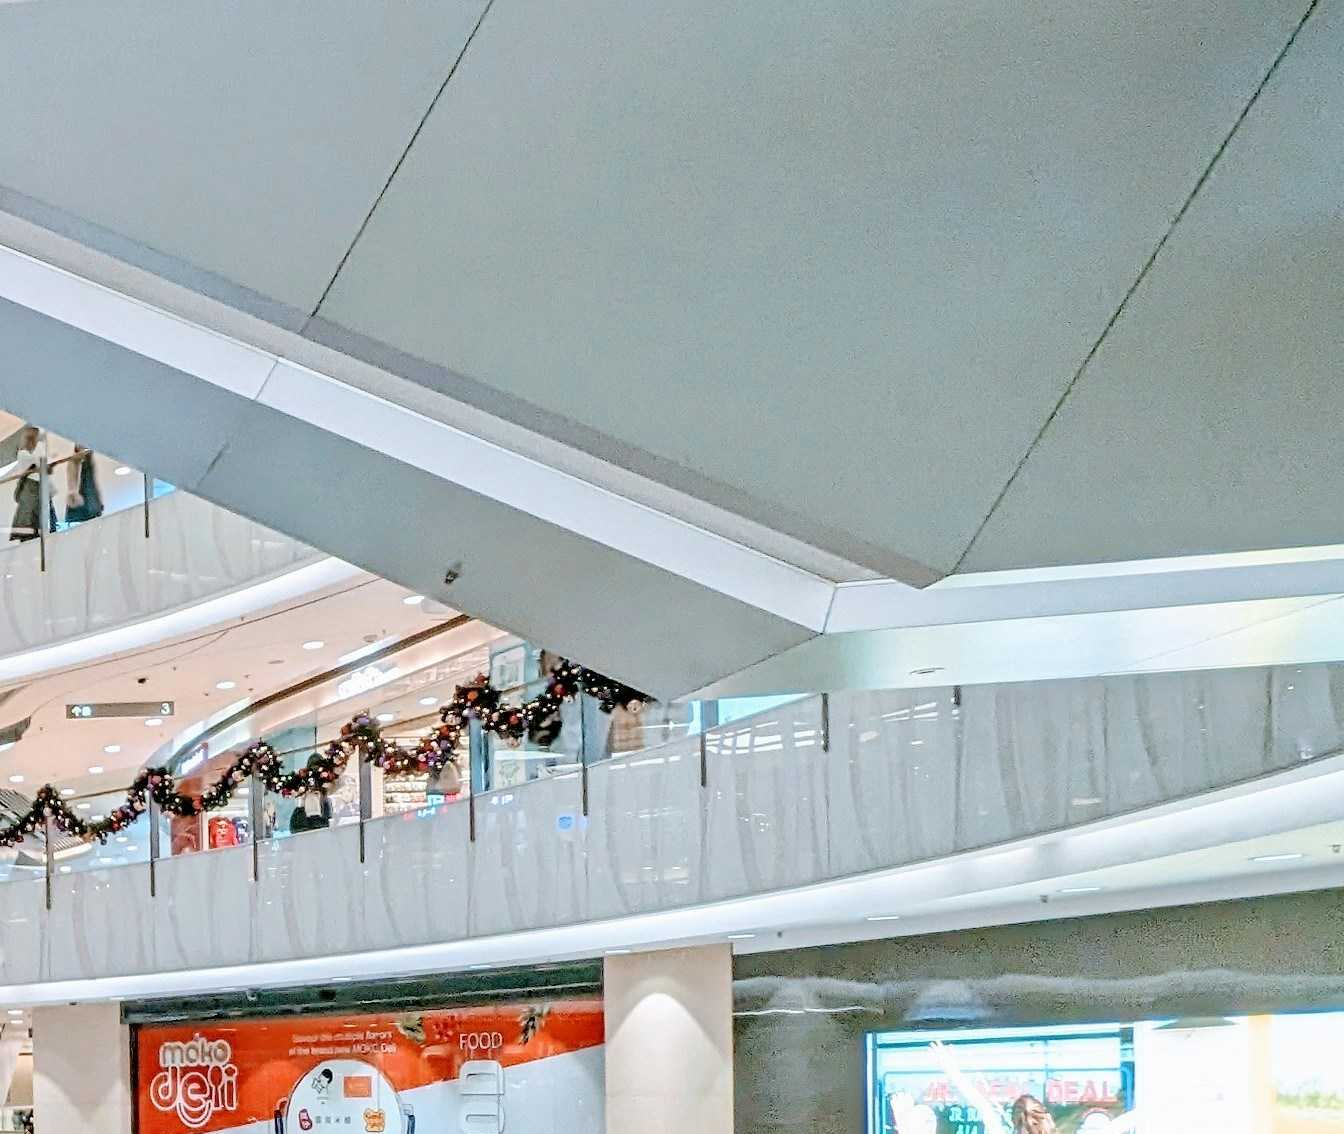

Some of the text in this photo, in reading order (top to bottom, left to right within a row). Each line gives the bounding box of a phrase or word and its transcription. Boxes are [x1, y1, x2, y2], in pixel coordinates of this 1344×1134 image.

[159, 1037, 231, 1068] moko
[459, 1031, 503, 1051] FOOD
[150, 1063, 239, 1127] deli
